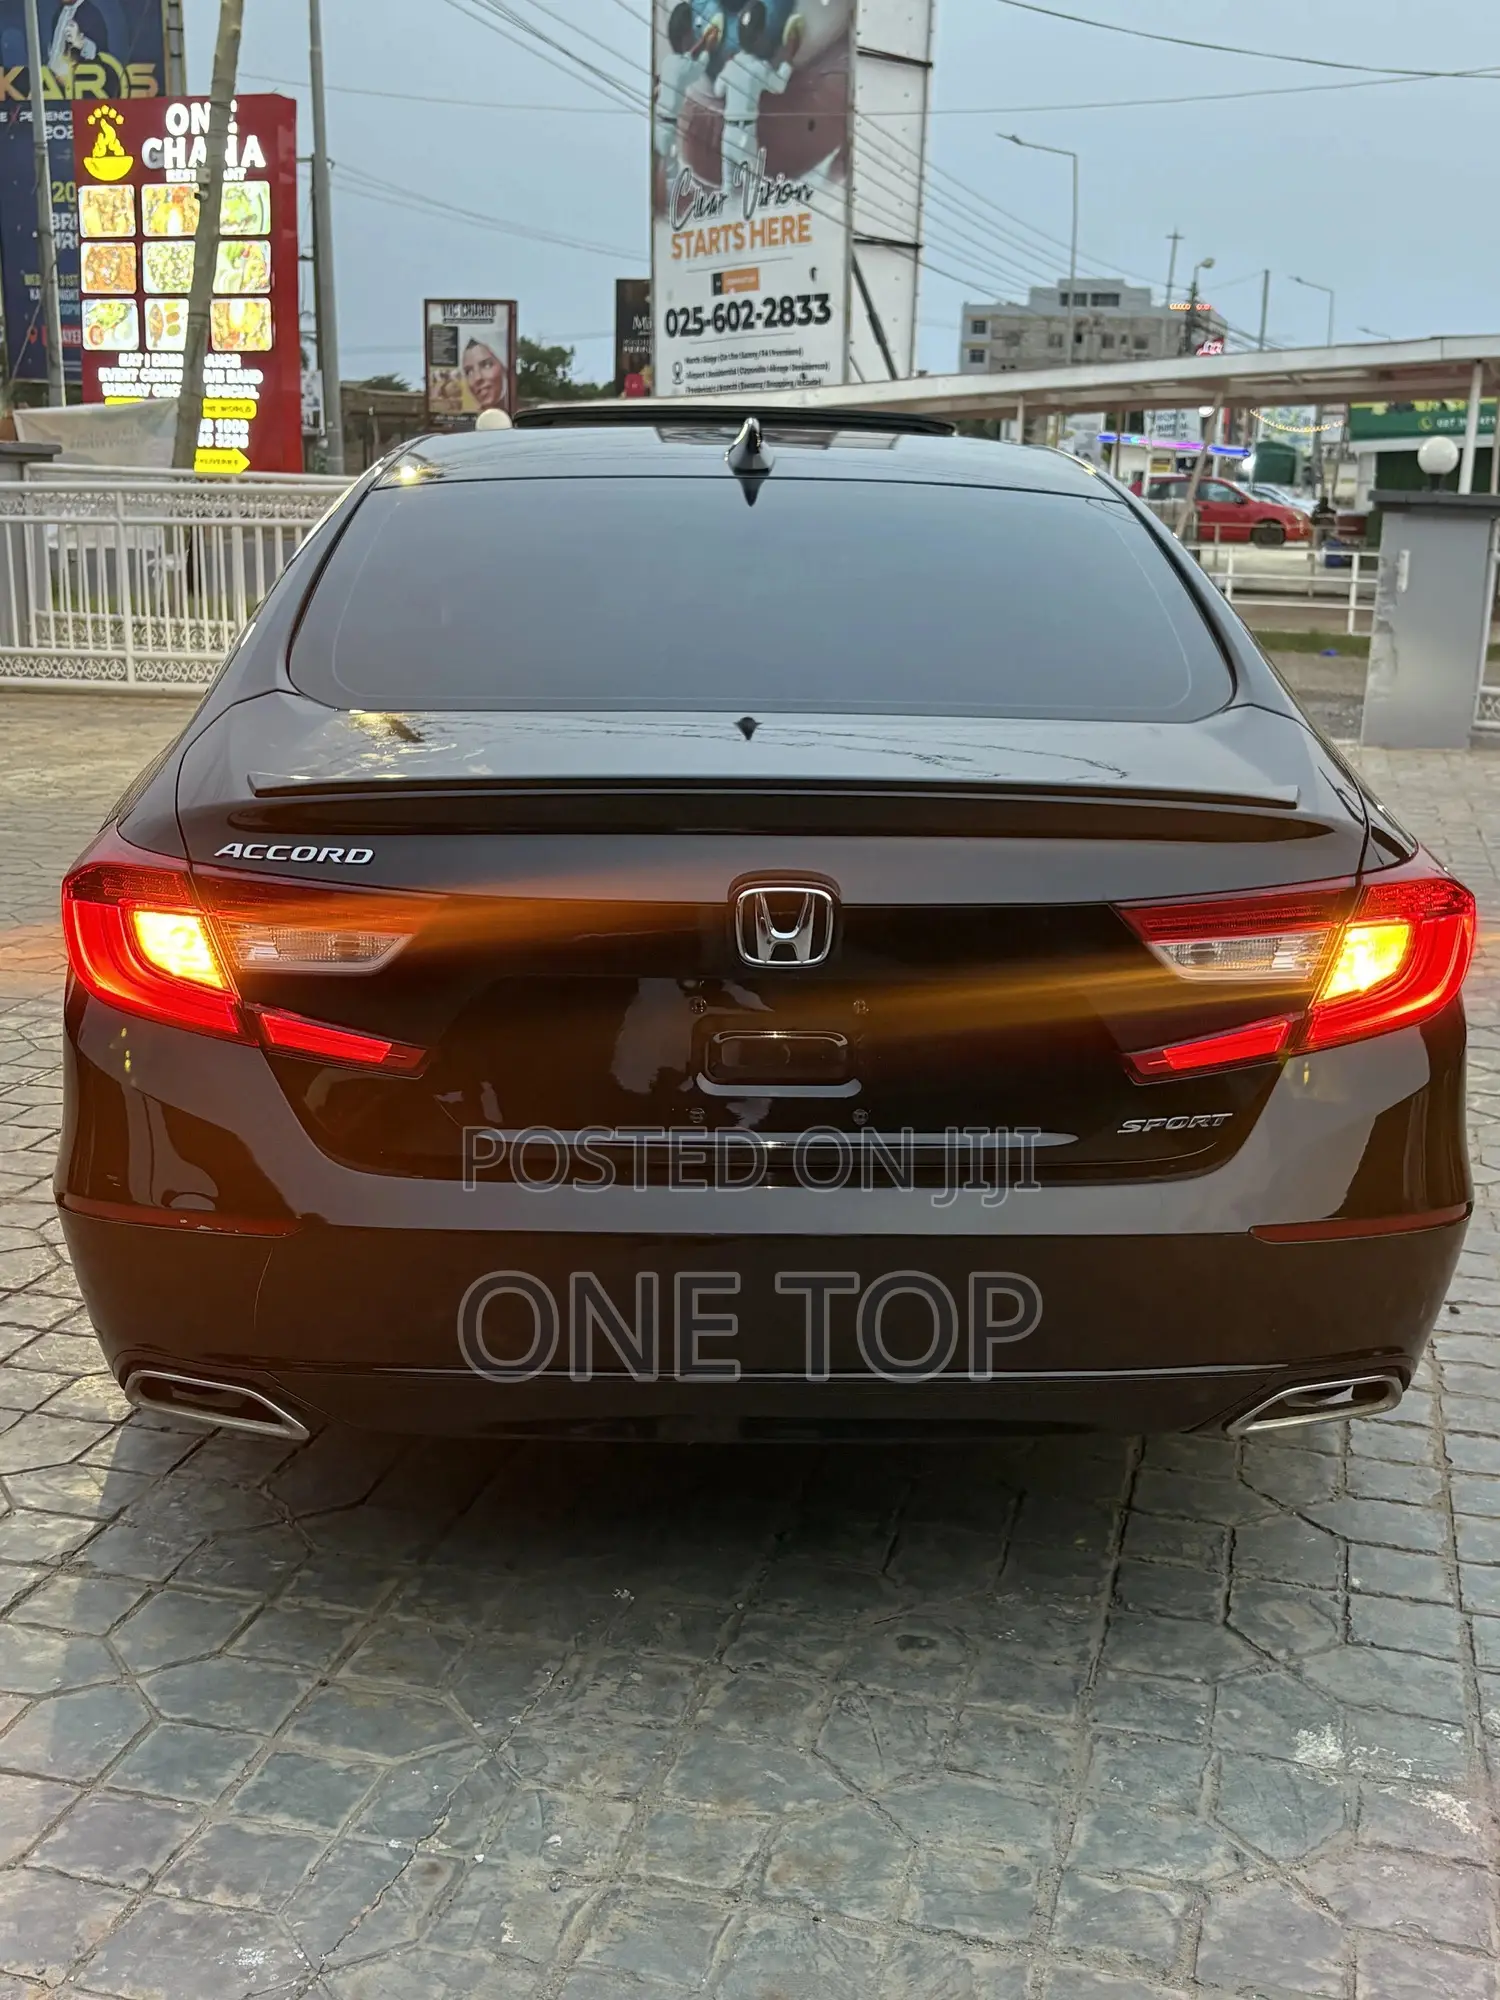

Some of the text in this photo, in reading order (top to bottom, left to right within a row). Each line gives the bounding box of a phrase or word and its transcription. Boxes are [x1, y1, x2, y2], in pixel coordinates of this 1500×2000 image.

[671, 212, 813, 260] STARTS HERE
[665, 294, 833, 338] 025-602-2833
[214, 842, 374, 864] ACCORD
[1116, 1112, 1234, 1134] SPORT
